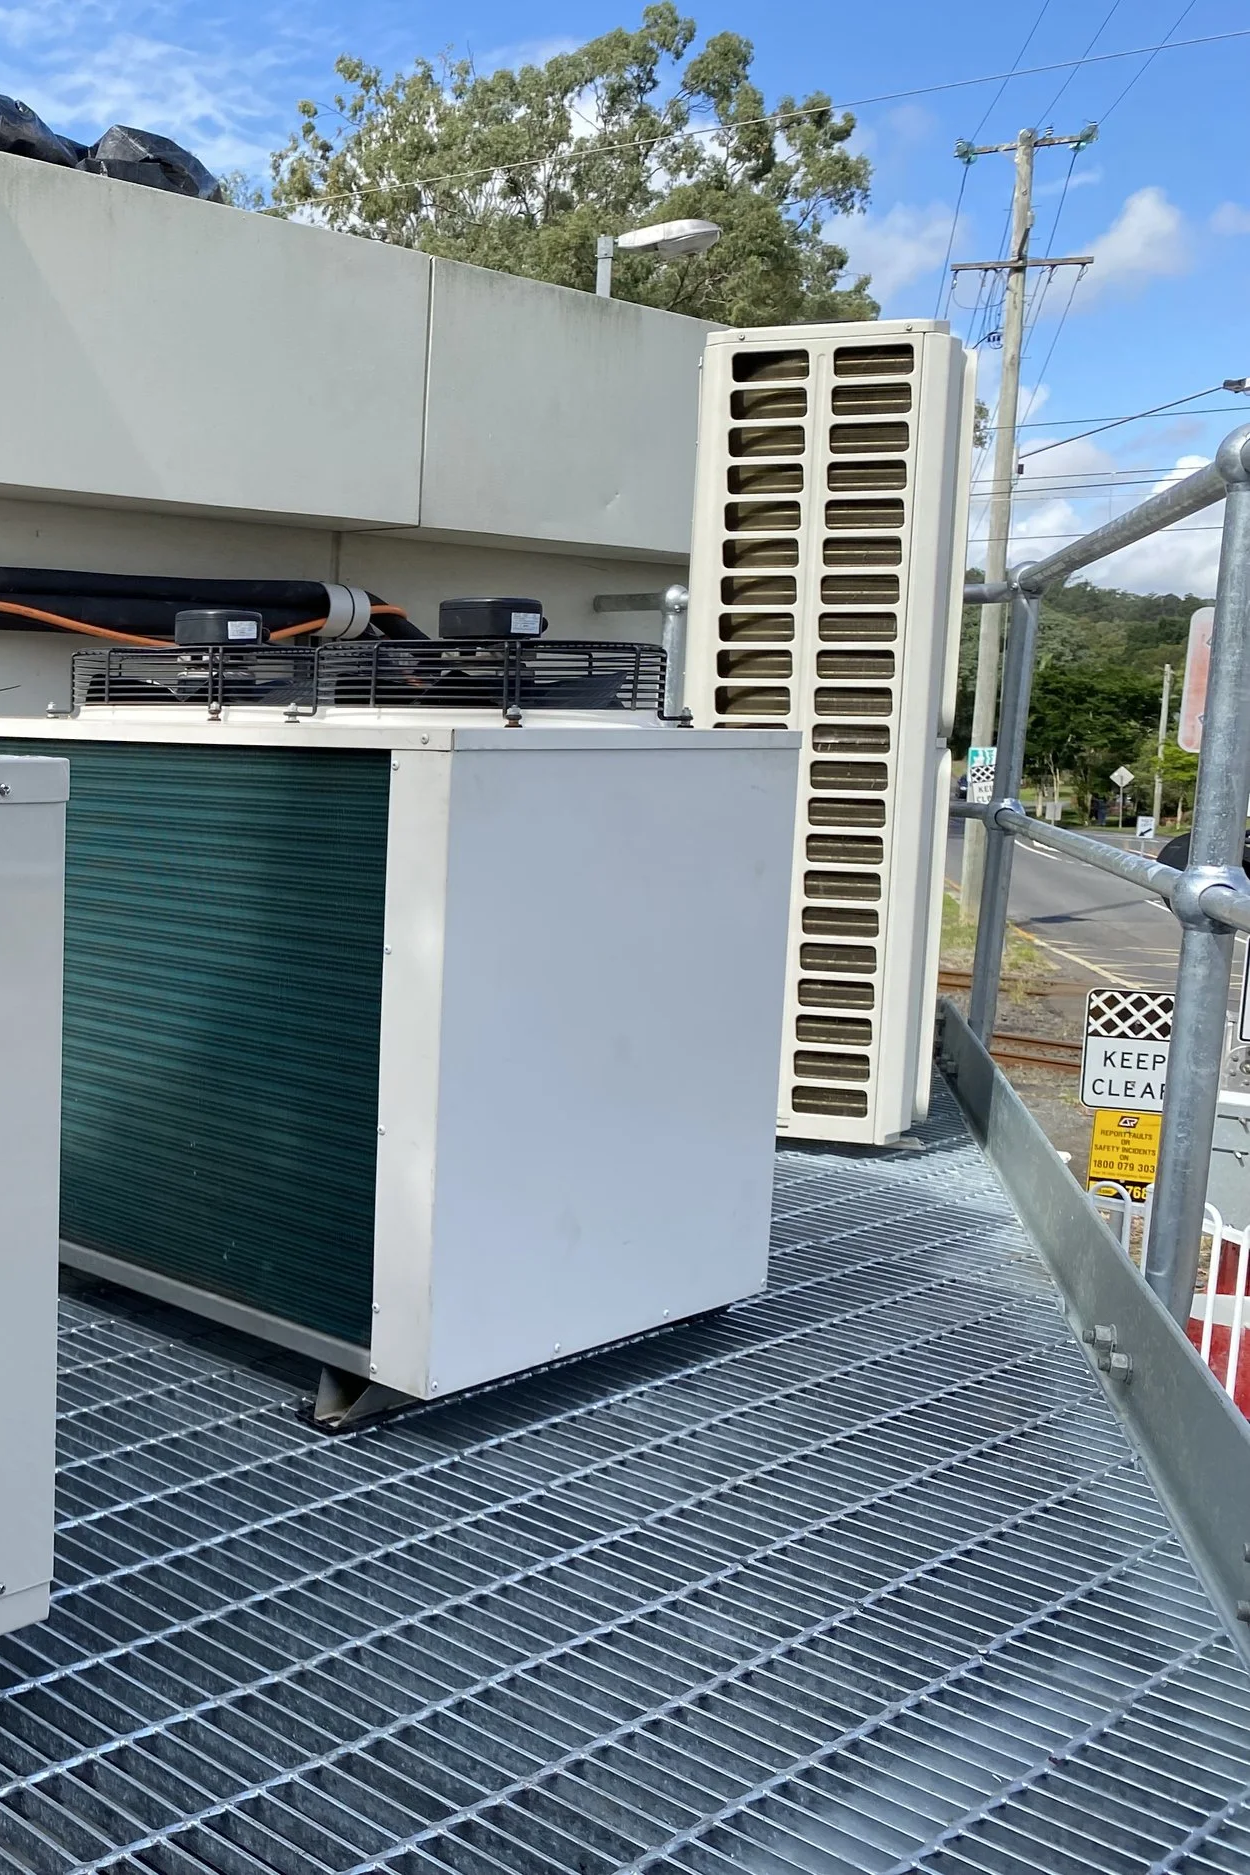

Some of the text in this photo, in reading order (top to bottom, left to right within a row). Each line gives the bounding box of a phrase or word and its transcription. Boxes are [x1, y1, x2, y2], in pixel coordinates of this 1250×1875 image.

[1103, 1050, 1166, 1071] KEEP
[1100, 1129, 1153, 1140] REPORT FAULTS
[1094, 1144, 1156, 1156] SAFETY INCIDENTS
[1093, 1159, 1155, 1174] 1800 079 303
